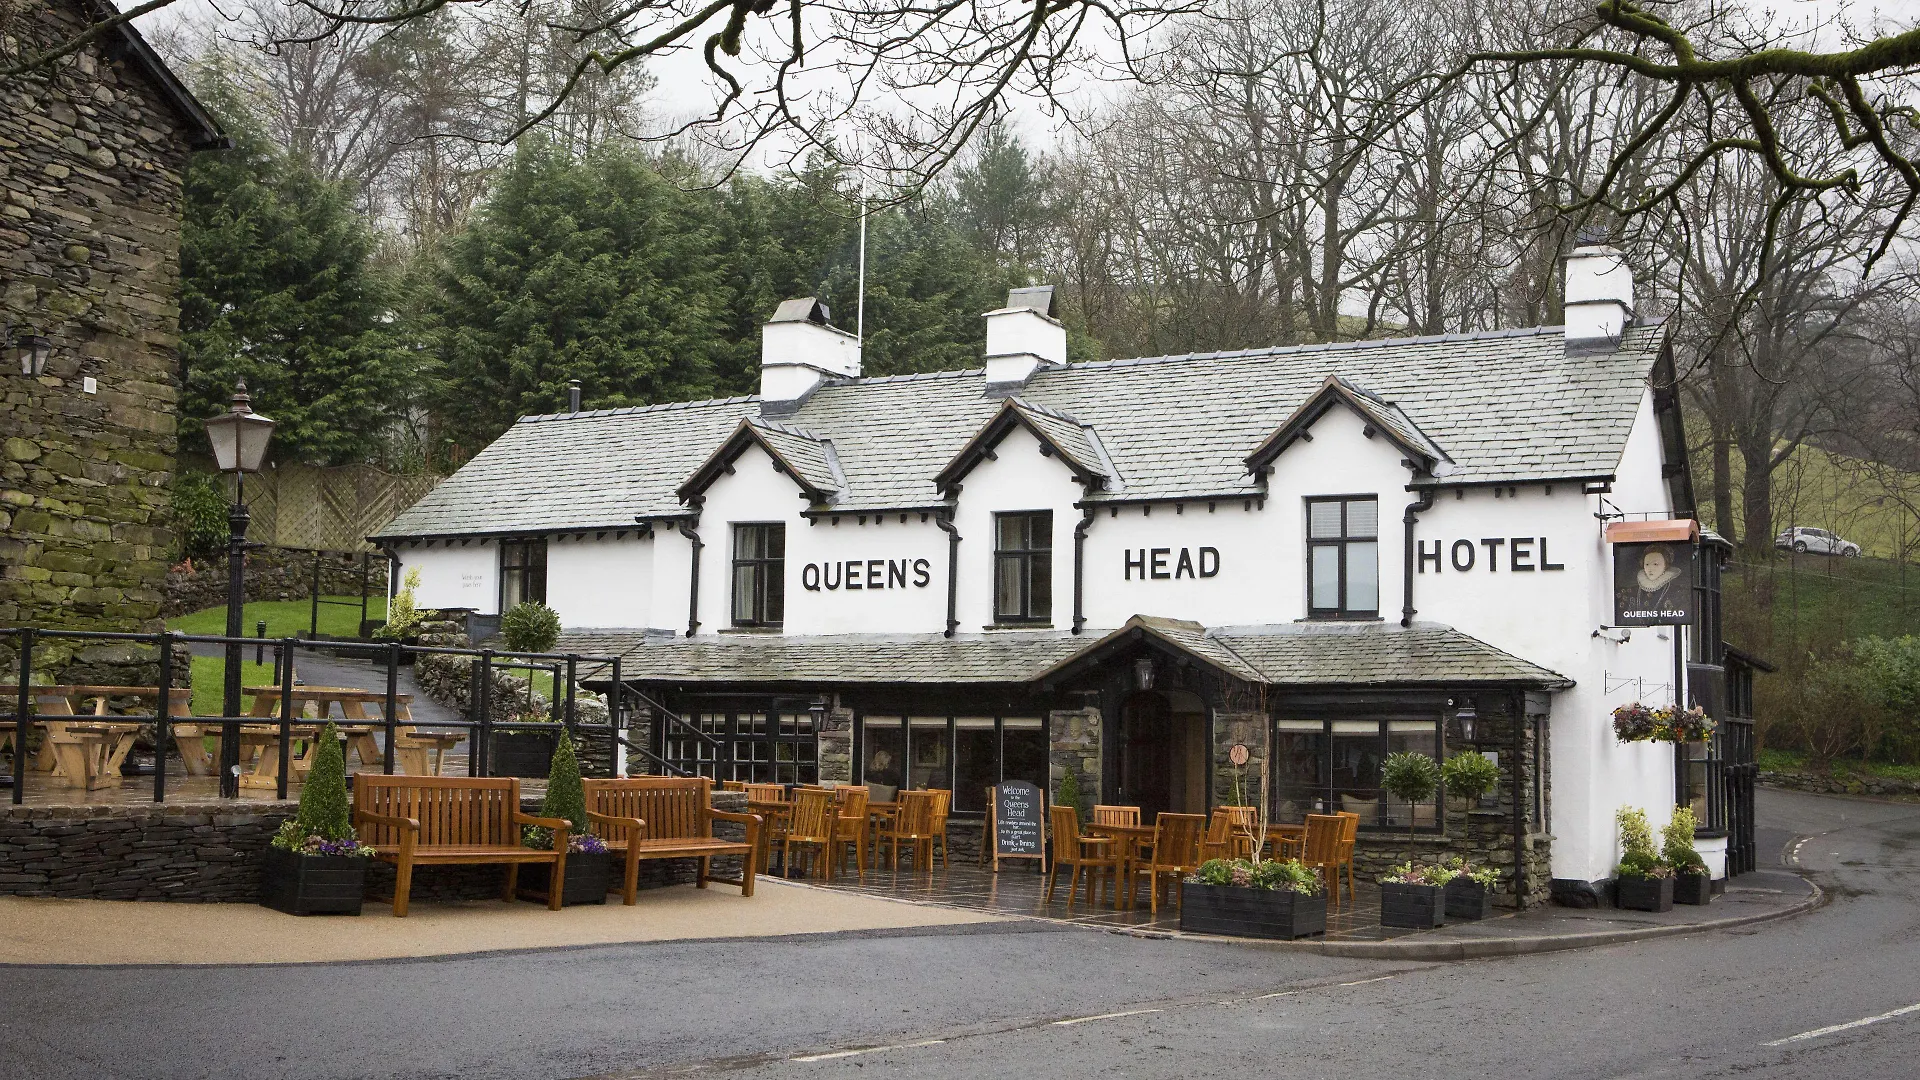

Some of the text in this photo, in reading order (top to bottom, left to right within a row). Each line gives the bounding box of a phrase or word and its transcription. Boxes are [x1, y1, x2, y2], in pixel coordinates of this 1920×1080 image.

[802, 537, 1565, 592] QUEEN'S HEAD HOTEL
[1623, 610, 1659, 618] QUEENS
[1002, 785, 1030, 795] Welcome
[1004, 799, 1029, 808] Queens
[1007, 808, 1025, 816] Head
[1001, 839, 1017, 847] Drink
[1019, 839, 1035, 848] Dining
